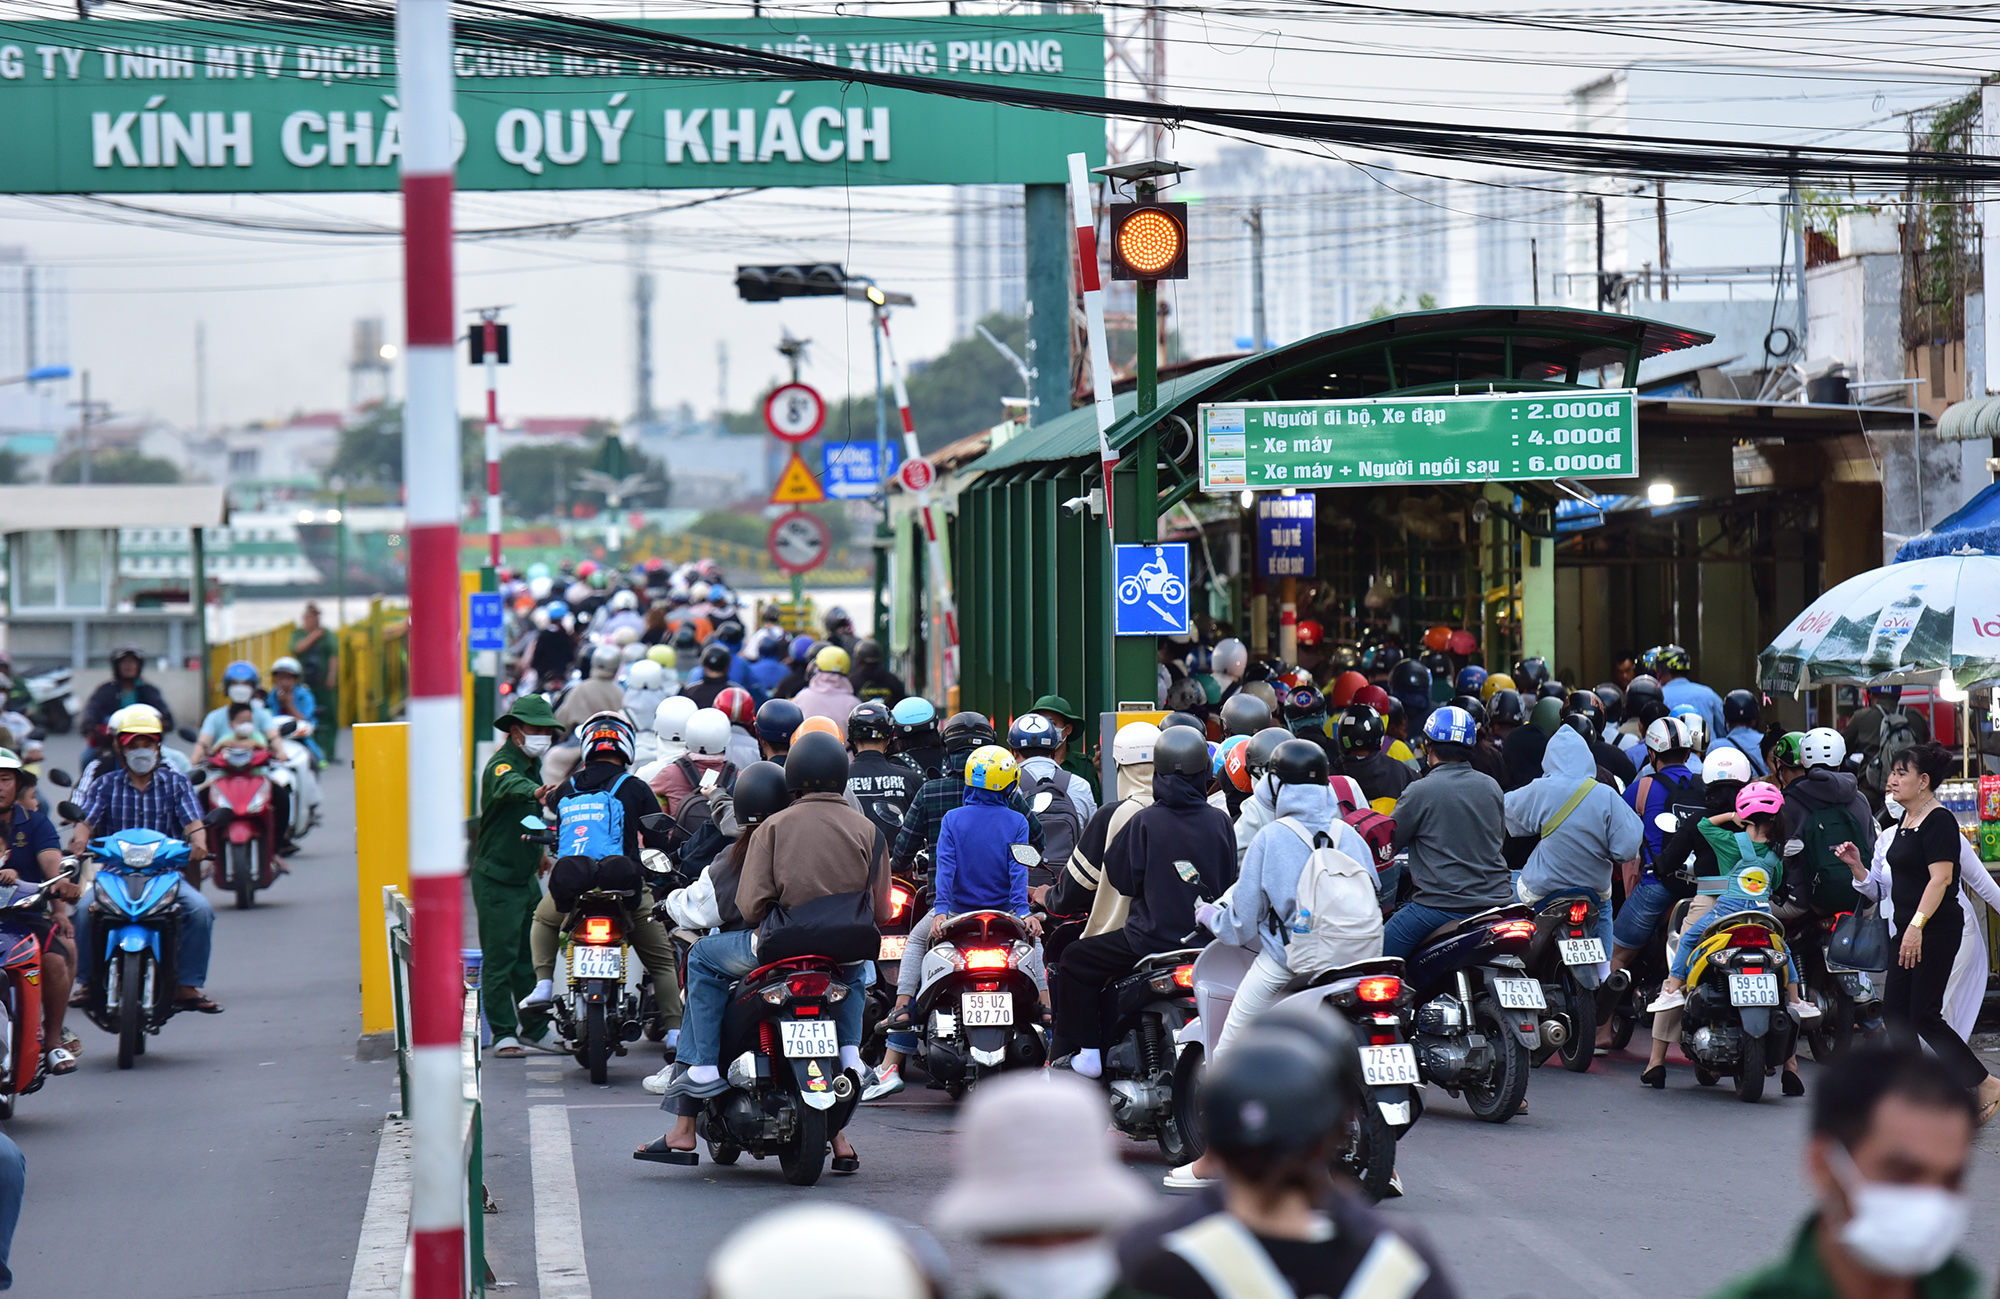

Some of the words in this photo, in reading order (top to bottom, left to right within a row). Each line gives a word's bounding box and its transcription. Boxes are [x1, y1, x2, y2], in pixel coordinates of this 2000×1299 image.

[35, 45, 85, 79] TY
[98, 45, 196, 79] TNHH
[205, 45, 286, 79] MTV
[297, 45, 382, 87] DỊCH
[847, 40, 938, 76] XUNG
[948, 39, 1064, 75] PHONG
[92, 94, 253, 168] KÍNH
[495, 92, 634, 175] QUÝ
[665, 89, 891, 165] KHÁCH
[1263, 410, 1318, 429] Người
[1324, 409, 1341, 426] đi
[1347, 408, 1376, 428] bộ,
[1382, 408, 1405, 424] Xe
[1412, 407, 1446, 425] đạp
[1527, 401, 1621, 420] 2.000đ
[1264, 438, 1287, 454] Xe
[1293, 436, 1333, 454] máy
[1527, 428, 1621, 446] 4.000đ
[1264, 464, 1287, 480] Xe
[1294, 462, 1333, 480] máy
[1339, 465, 1352, 476] +
[1359, 460, 1413, 478] Người
[1420, 457, 1460, 477] ngồi
[1466, 460, 1499, 474] sau
[1528, 454, 1622, 472] 6.000đ
[847, 776, 872, 791] NEW
[874, 775, 905, 790] YORK
[1567, 939, 1596, 952] 48-B1
[580, 947, 614, 962] 72-H5
[1566, 951, 1604, 964] 460.54
[580, 962, 614, 976] 9444
[1502, 980, 1534, 993] 72-G1
[1736, 976, 1769, 990] 59-C1
[970, 995, 1005, 1009] 59-U2
[1502, 993, 1543, 1007] 788.14
[1733, 991, 1775, 1005] 155.03
[967, 1009, 1010, 1024] 287.70
[790, 1023, 827, 1038] 72-F1
[786, 1039, 835, 1055] 790.85
[1368, 1048, 1407, 1065] 72-F1
[1368, 1065, 1416, 1082] 949.64
